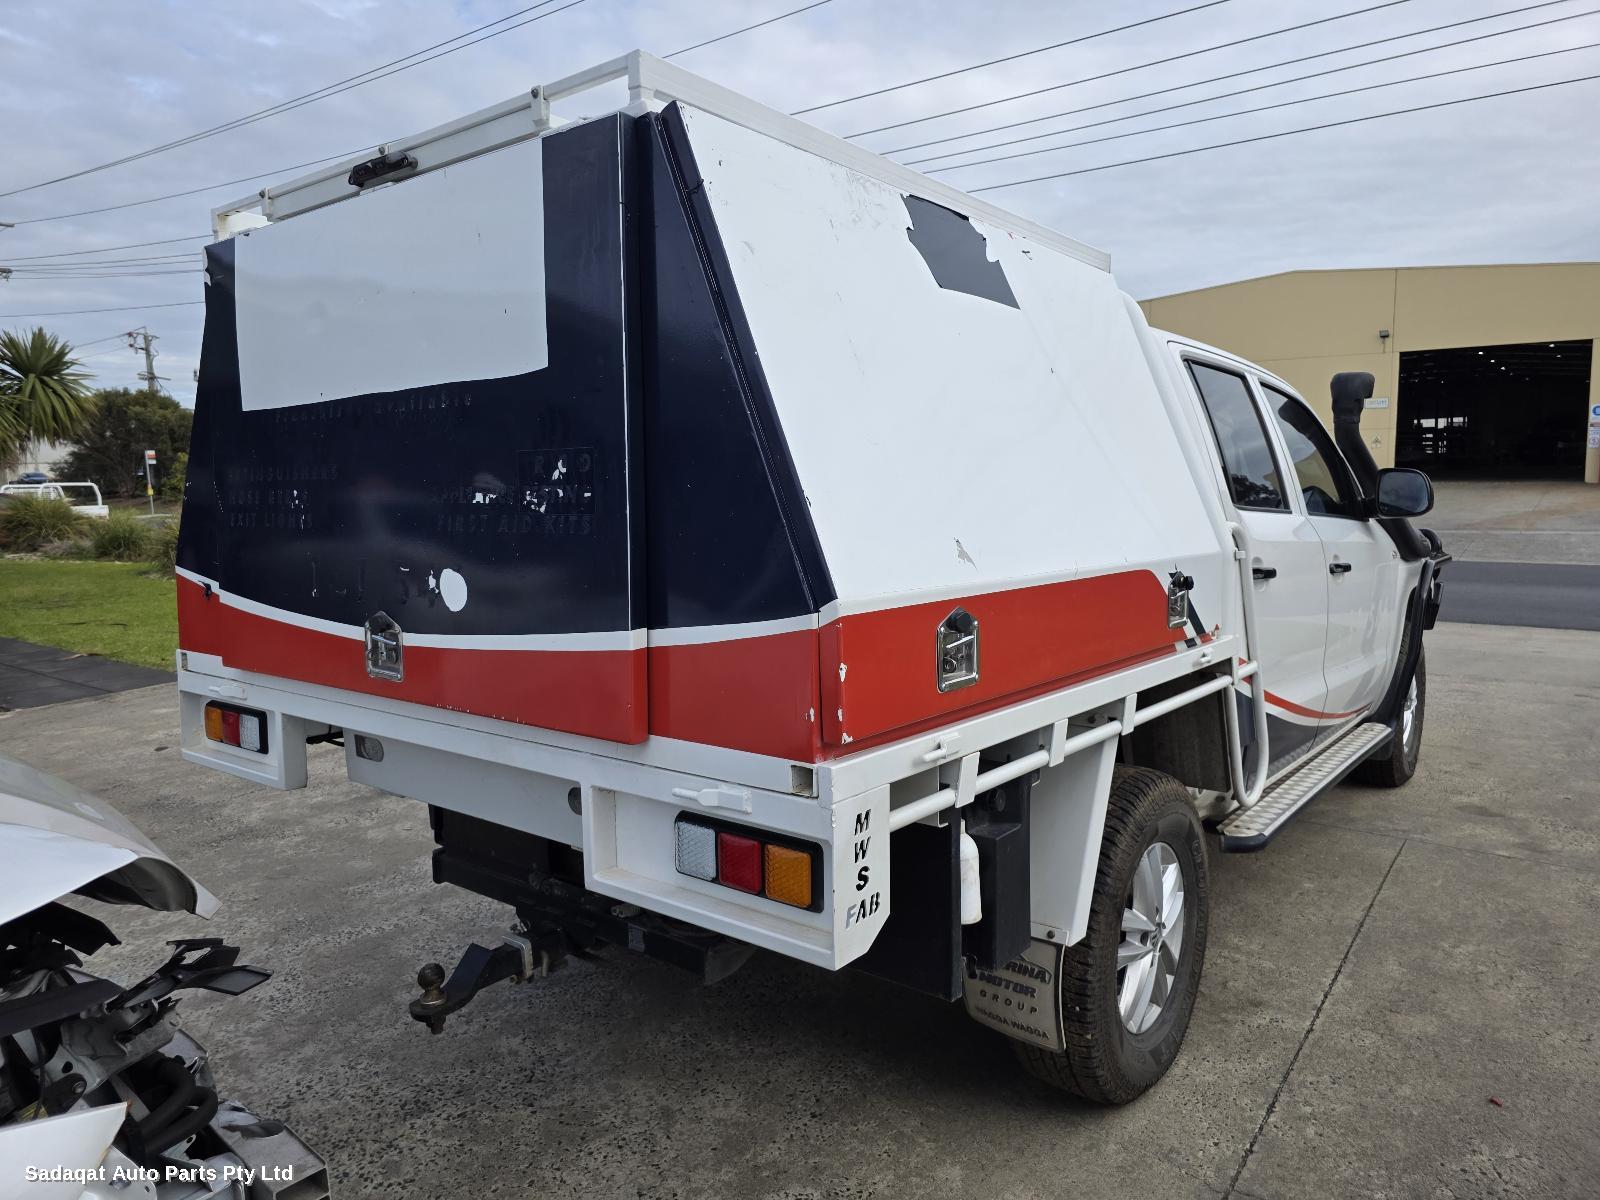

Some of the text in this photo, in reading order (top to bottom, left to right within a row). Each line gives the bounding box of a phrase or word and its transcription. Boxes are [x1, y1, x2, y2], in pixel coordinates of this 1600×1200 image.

[845, 891, 880, 929] FAB
[979, 970, 1037, 998] MOTOR
[980, 989, 1038, 1014] GROUP
[1010, 1019, 1050, 1041] WAGGA
